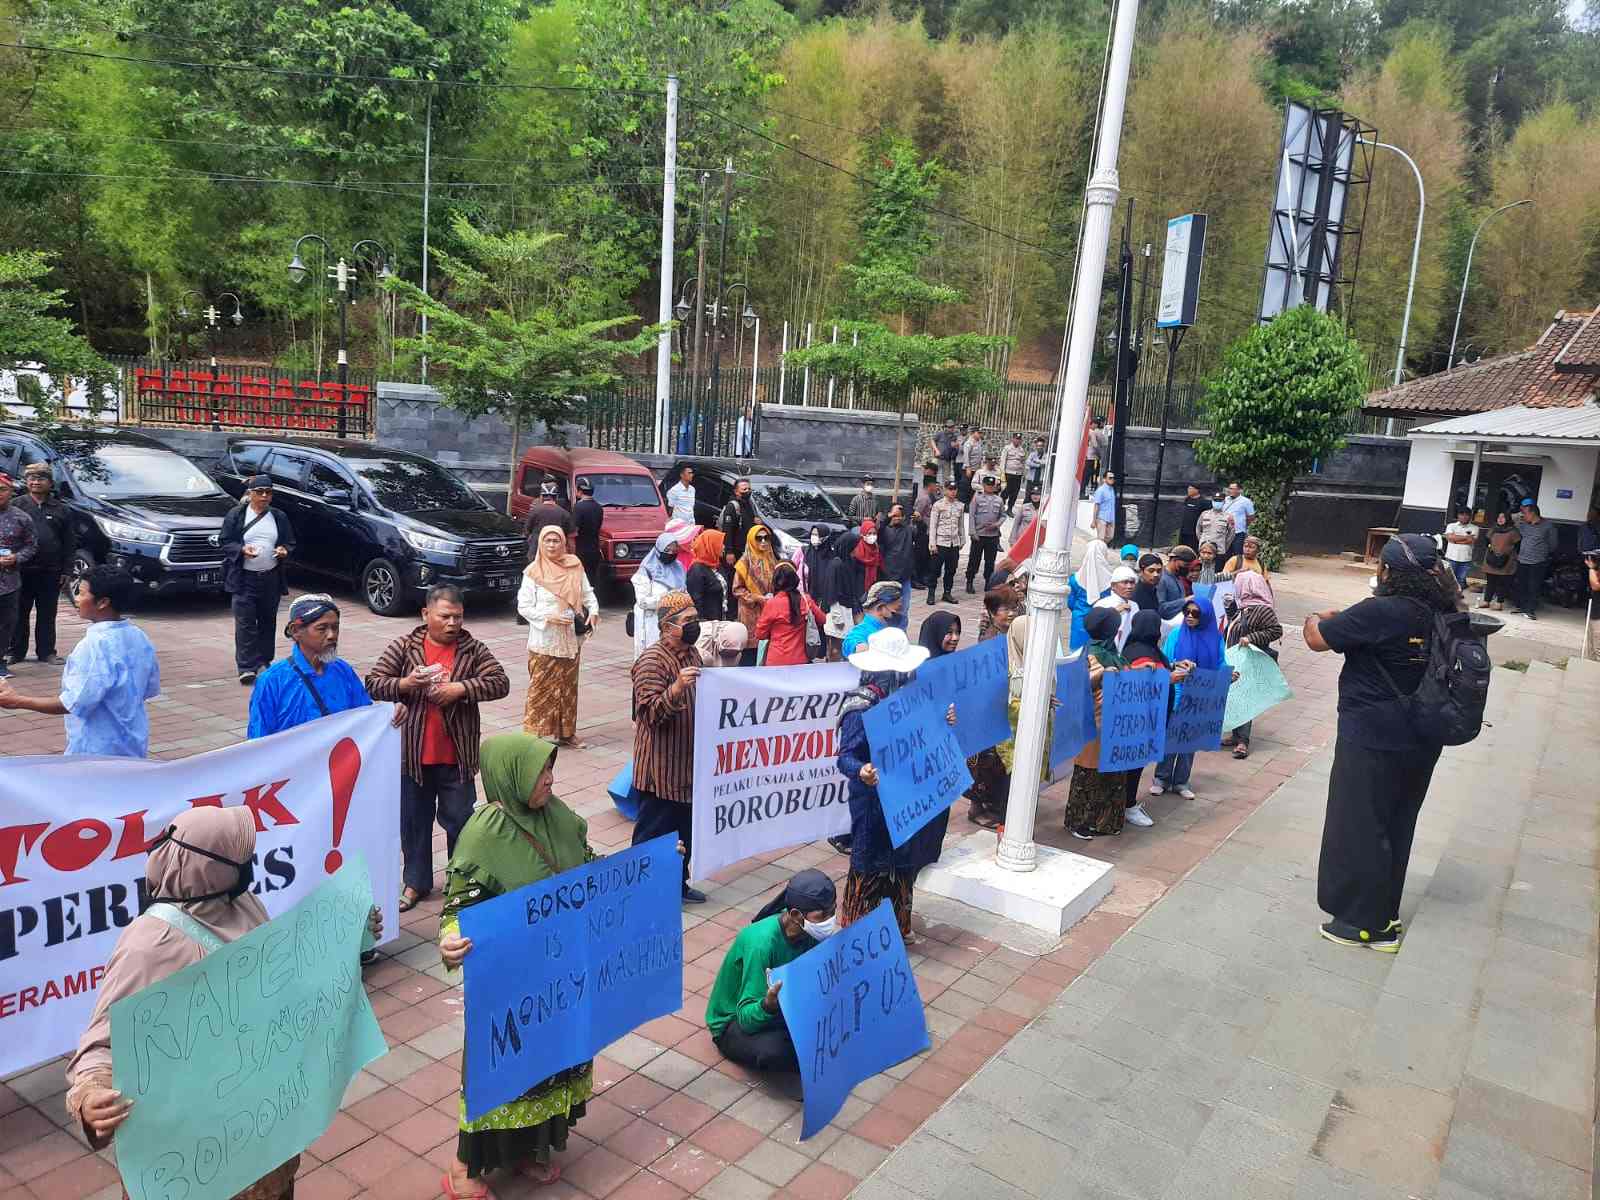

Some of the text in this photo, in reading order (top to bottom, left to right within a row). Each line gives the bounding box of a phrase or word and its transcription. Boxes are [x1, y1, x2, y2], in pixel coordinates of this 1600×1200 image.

[888, 682, 934, 725] BUMN
[713, 766, 840, 799] PELAKU USAHA & MASY
[877, 727, 927, 775] TIDAK
[0, 779, 301, 886] TOLK
[892, 792, 937, 832] KELOLA
[526, 855, 652, 925] BOROBUDUR
[545, 894, 632, 959] IS NOT
[816, 925, 891, 995] UNESCO
[489, 930, 682, 1072] MONEY MACHINE
